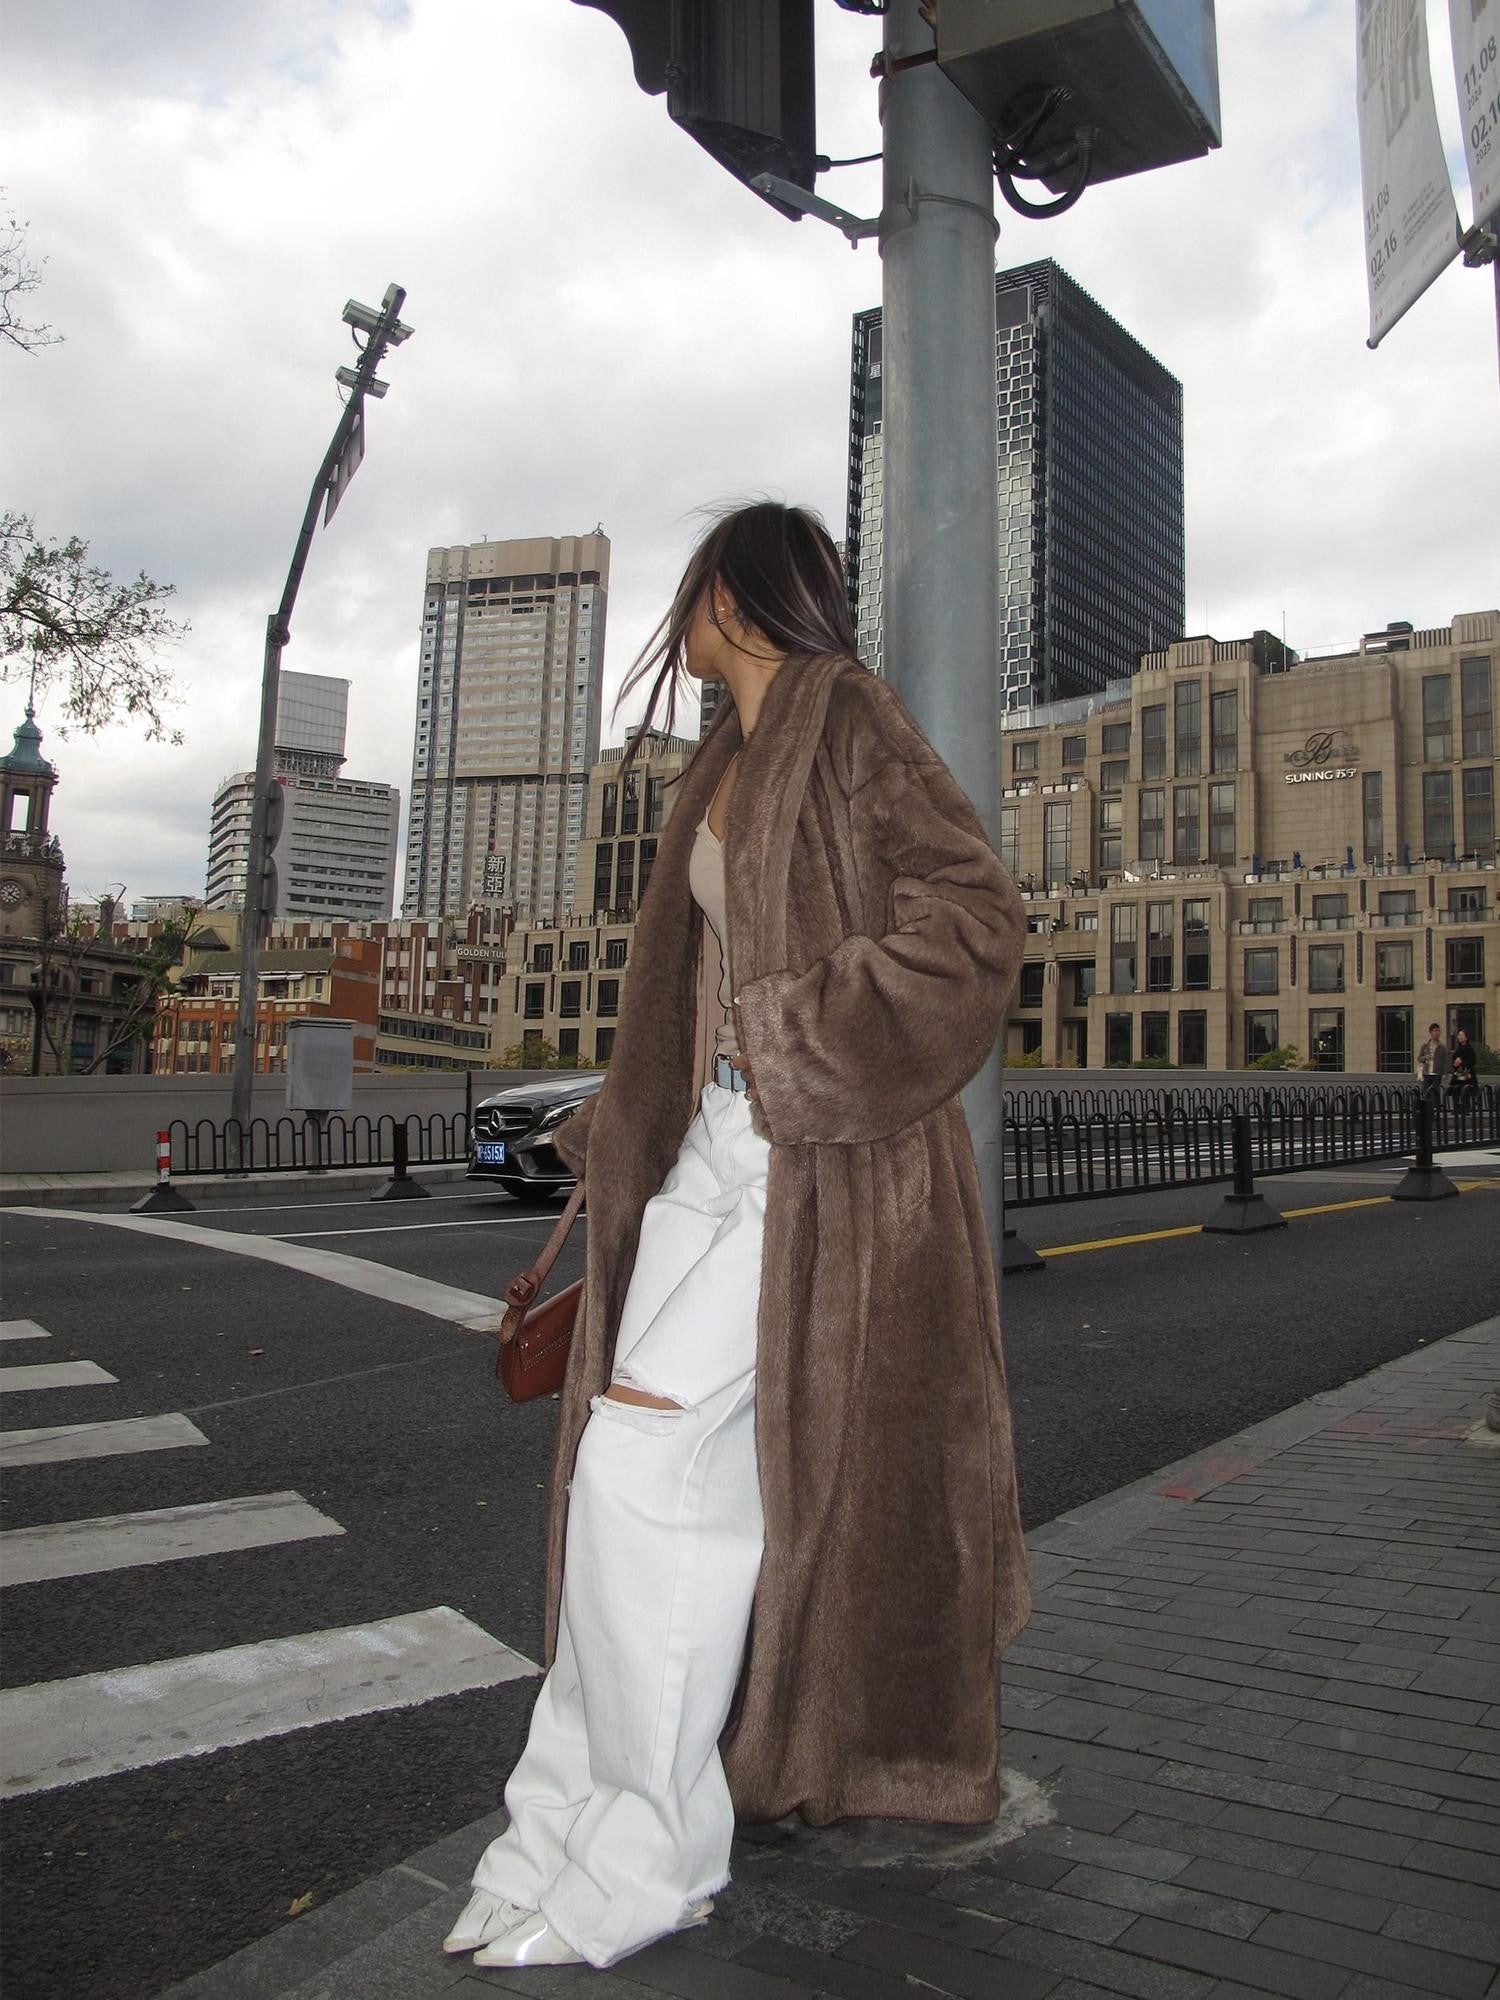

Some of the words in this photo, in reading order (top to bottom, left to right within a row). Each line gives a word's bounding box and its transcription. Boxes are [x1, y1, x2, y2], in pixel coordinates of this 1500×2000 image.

[1463, 36, 1497, 95] 11.08
[1475, 139, 1491, 165] 2025
[1366, 183, 1390, 231] 11.08
[1371, 231, 1397, 277] 02.16
[1285, 770, 1333, 785] SUNING
[457, 947, 490, 958] GOLDEN
